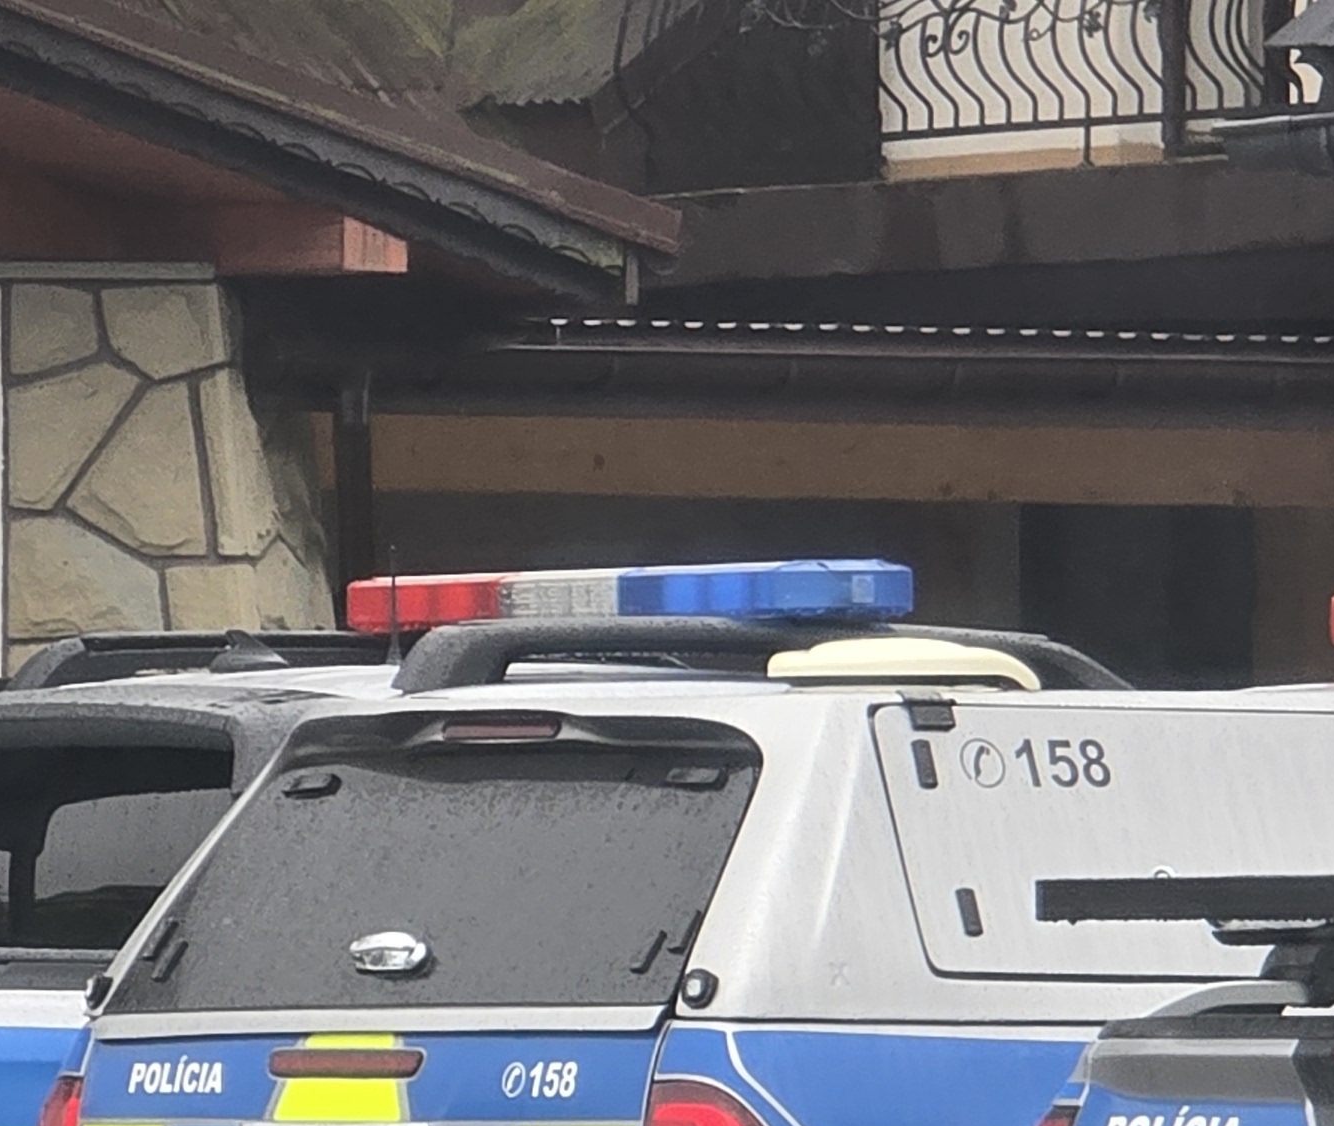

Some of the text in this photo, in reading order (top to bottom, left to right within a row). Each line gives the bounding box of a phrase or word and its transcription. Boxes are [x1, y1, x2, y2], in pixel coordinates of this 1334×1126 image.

[1014, 739, 1111, 788] 158
[128, 1055, 224, 1095] POLÍCIA
[529, 1061, 579, 1099] 158
